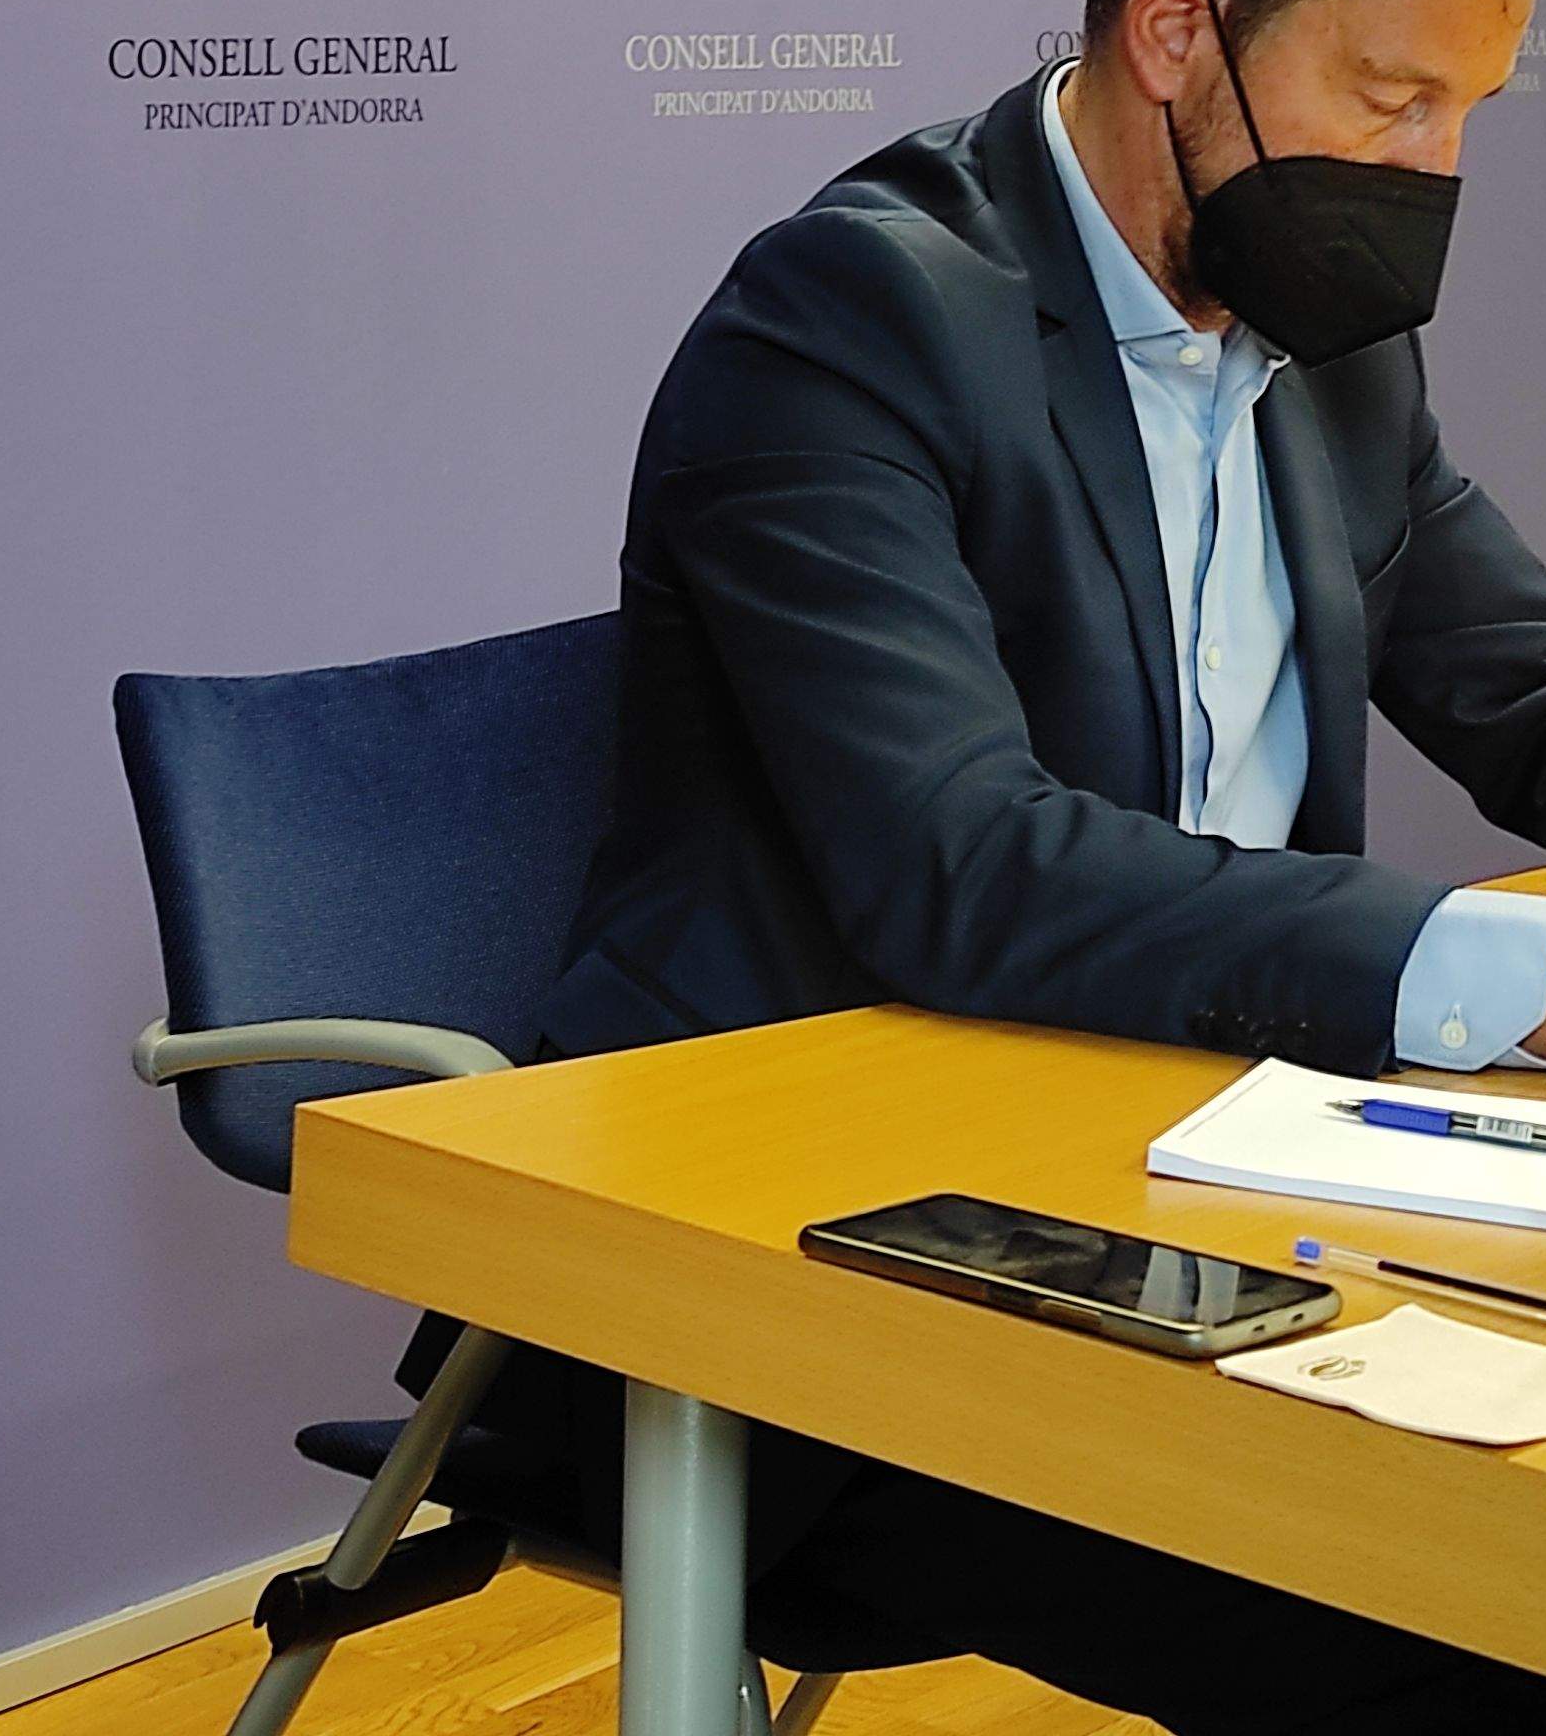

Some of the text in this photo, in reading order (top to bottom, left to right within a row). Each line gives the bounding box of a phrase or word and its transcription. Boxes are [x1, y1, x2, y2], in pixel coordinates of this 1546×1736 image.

[108, 35, 458, 79] CONSELL GENERAL
[625, 33, 903, 71] CONSELL GENERAL
[144, 97, 425, 130] PRINCIPAT D'ANDORRA
[653, 87, 875, 116] PRINCIPAT D'ANDORRA
